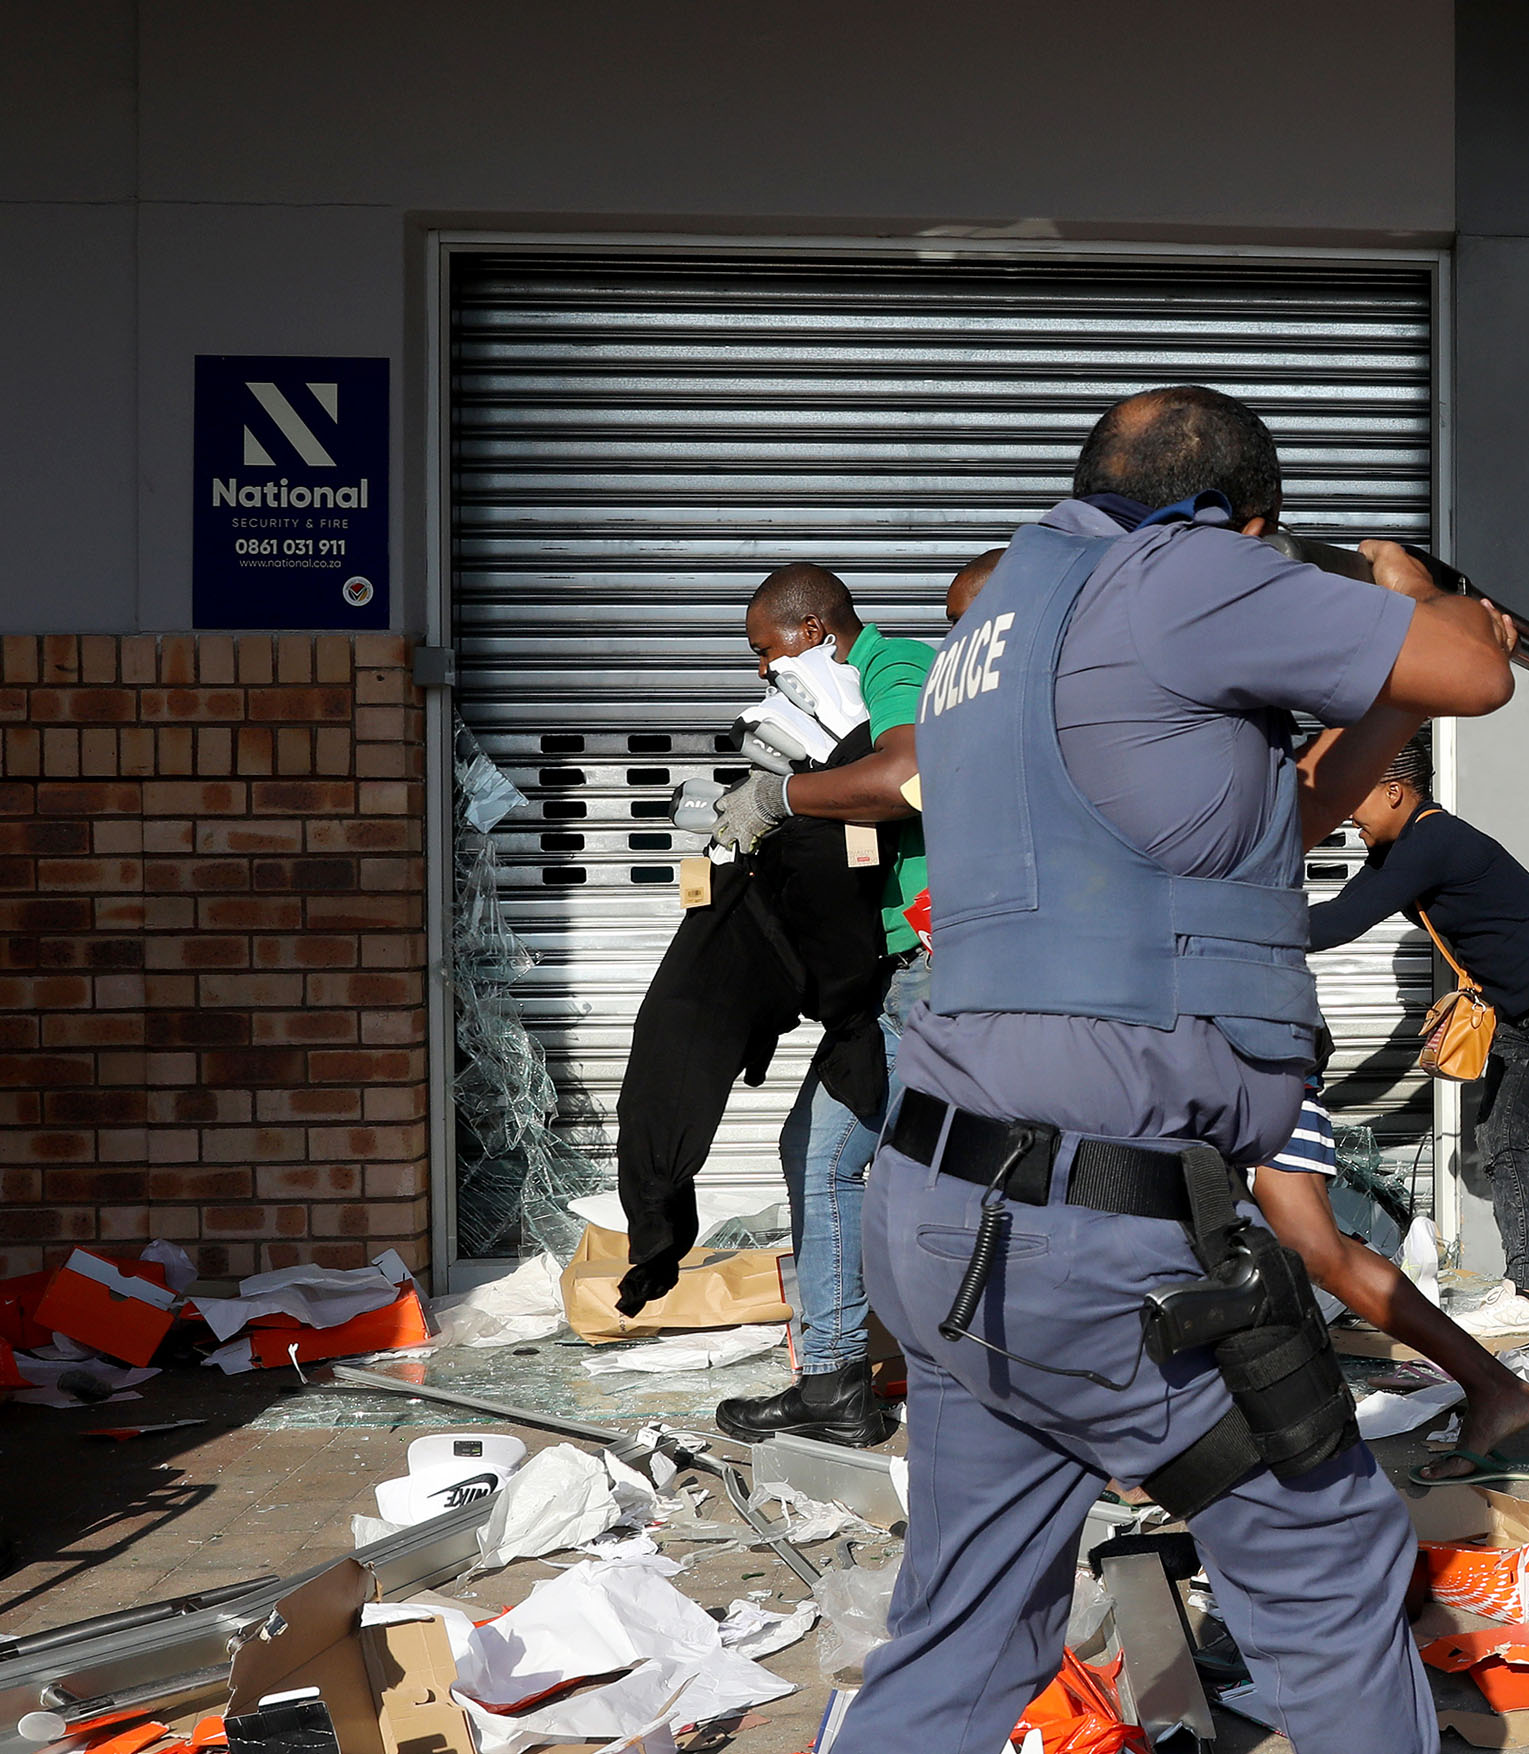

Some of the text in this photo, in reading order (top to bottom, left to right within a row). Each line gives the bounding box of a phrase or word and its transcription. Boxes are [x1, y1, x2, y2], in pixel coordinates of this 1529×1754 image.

[212, 478, 368, 508] National
[231, 517, 349, 529] SECURITY & FIRE
[235, 538, 345, 555] 0861 031 911
[239, 558, 341, 568] www.national.co.za
[920, 611, 1016, 724] POLICE
